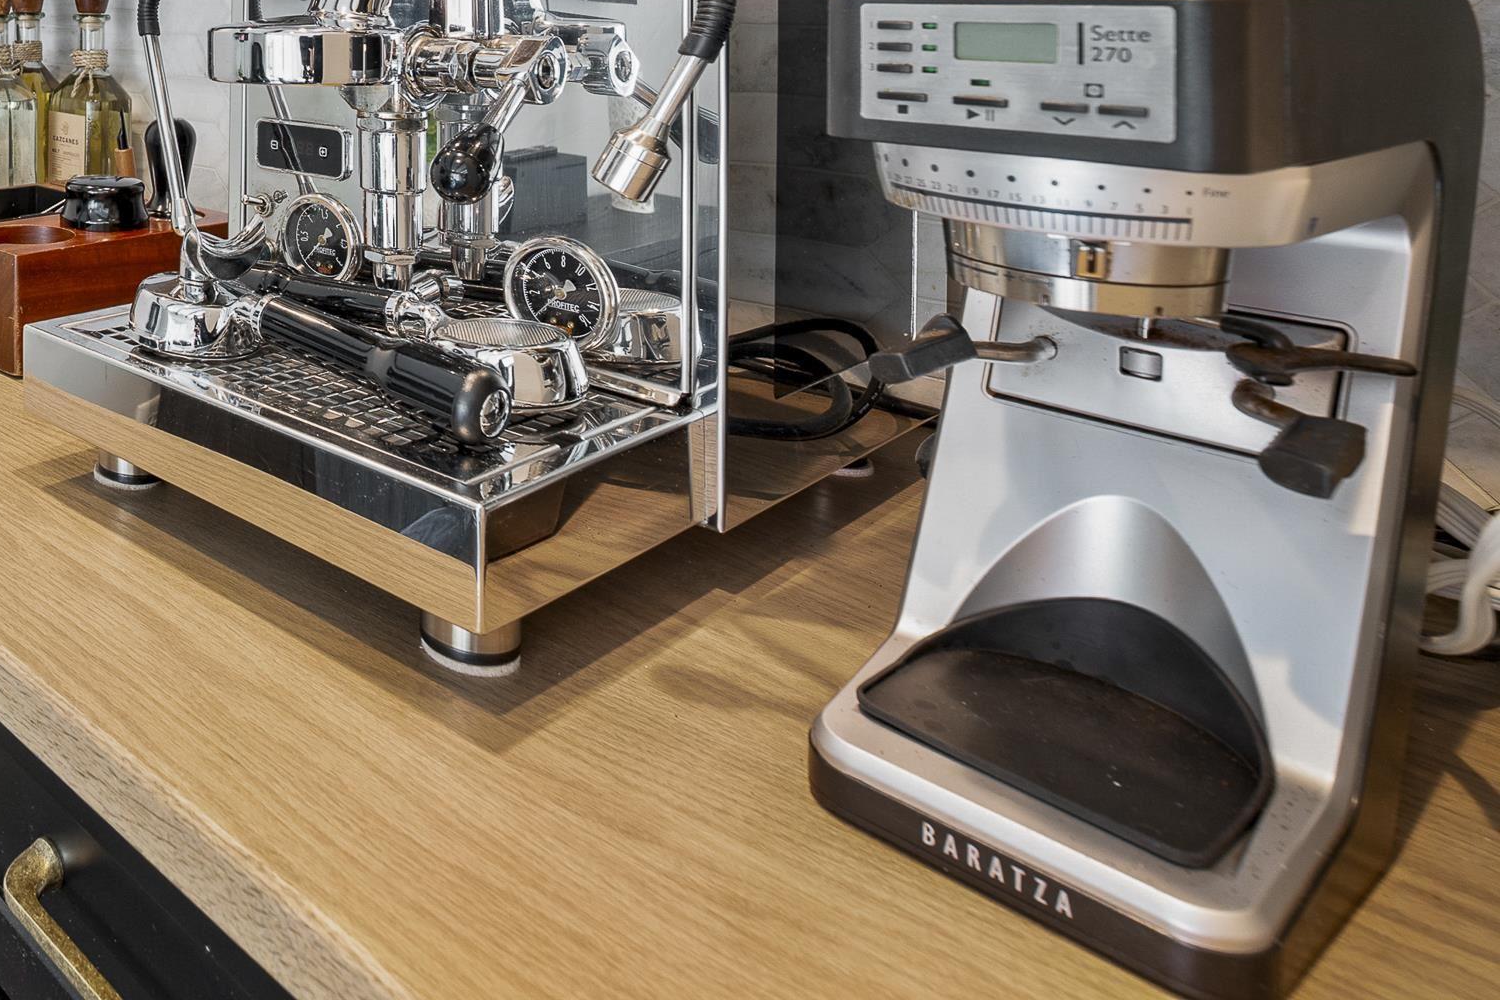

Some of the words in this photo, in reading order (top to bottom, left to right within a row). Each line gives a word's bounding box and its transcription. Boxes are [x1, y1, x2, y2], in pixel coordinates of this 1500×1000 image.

[1090, 24, 1153, 42] Sette
[867, 41, 875, 50] 2
[1091, 46, 1133, 63] 270
[867, 62, 875, 72] 3
[52, 135, 79, 146] CAZCANES
[966, 187, 980, 196] 19
[987, 189, 1000, 198] 17
[543, 257, 551, 270] 6
[560, 255, 567, 268] 8
[574, 263, 586, 277] 10
[547, 298, 580, 313] PROFITEC
[586, 300, 601, 312] 14
[920, 820, 1074, 920] BARATZA
